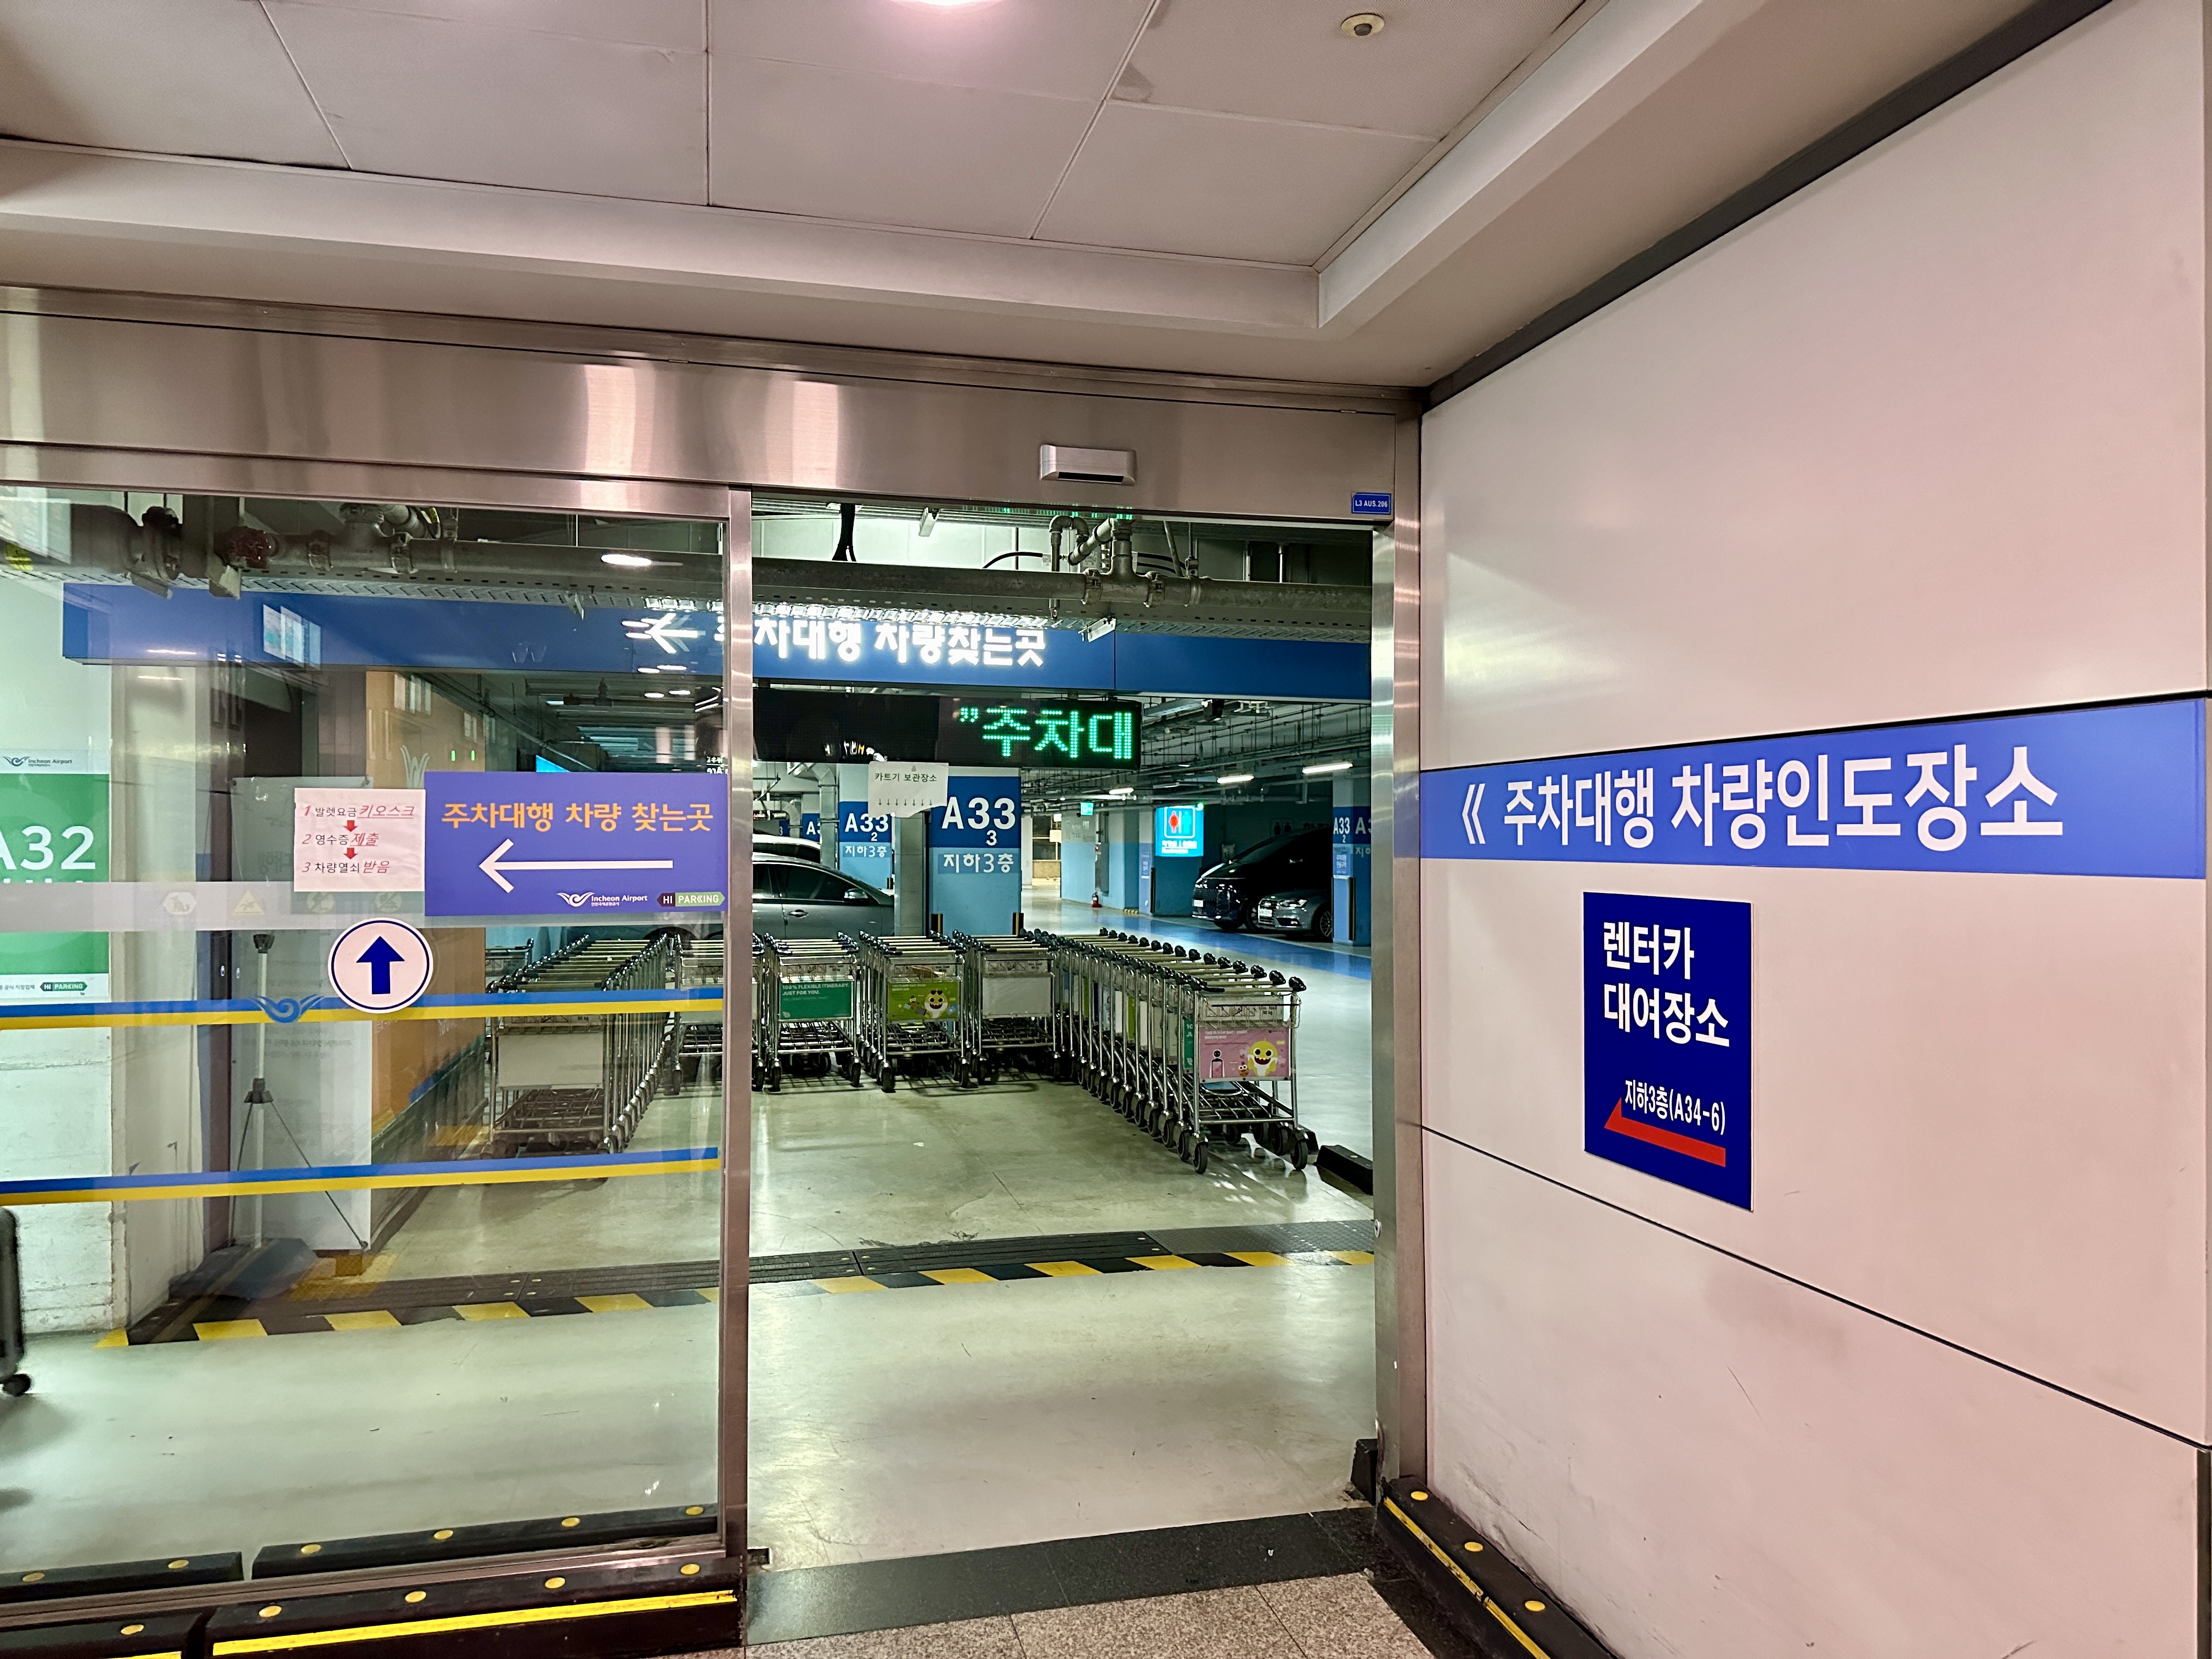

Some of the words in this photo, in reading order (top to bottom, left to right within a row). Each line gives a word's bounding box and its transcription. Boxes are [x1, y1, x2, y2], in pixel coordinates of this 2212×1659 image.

[714, 616, 861, 662] 차대행
[874, 623, 1046, 667] 차량찾는곳
[874, 772, 900, 782] 카트기
[904, 773, 938, 783] 보관장소
[1503, 770, 1656, 849] 주차대행
[1671, 744, 2063, 853] 차량인도장소
[303, 805, 312, 816] 1
[442, 803, 554, 832] 주차대행
[566, 804, 620, 831] 차량
[632, 803, 714, 832] 찾는곳
[941, 797, 1016, 830] A33
[845, 813, 889, 833] A33
[1333, 817, 1350, 834] A33
[302, 834, 311, 844] 2
[871, 832, 878, 841] 2
[986, 830, 997, 846] 3
[845, 845, 887, 858] 지하3층
[302, 862, 311, 872] 3
[943, 853, 1014, 873] 지하3층
[663, 896, 673, 904] HI
[678, 895, 719, 904] PARKING
[1603, 920, 1695, 980] 렌터카
[1604, 983, 1730, 1048] 대여장소
[1624, 1077, 1726, 1137] 지하3층(A34-6)
